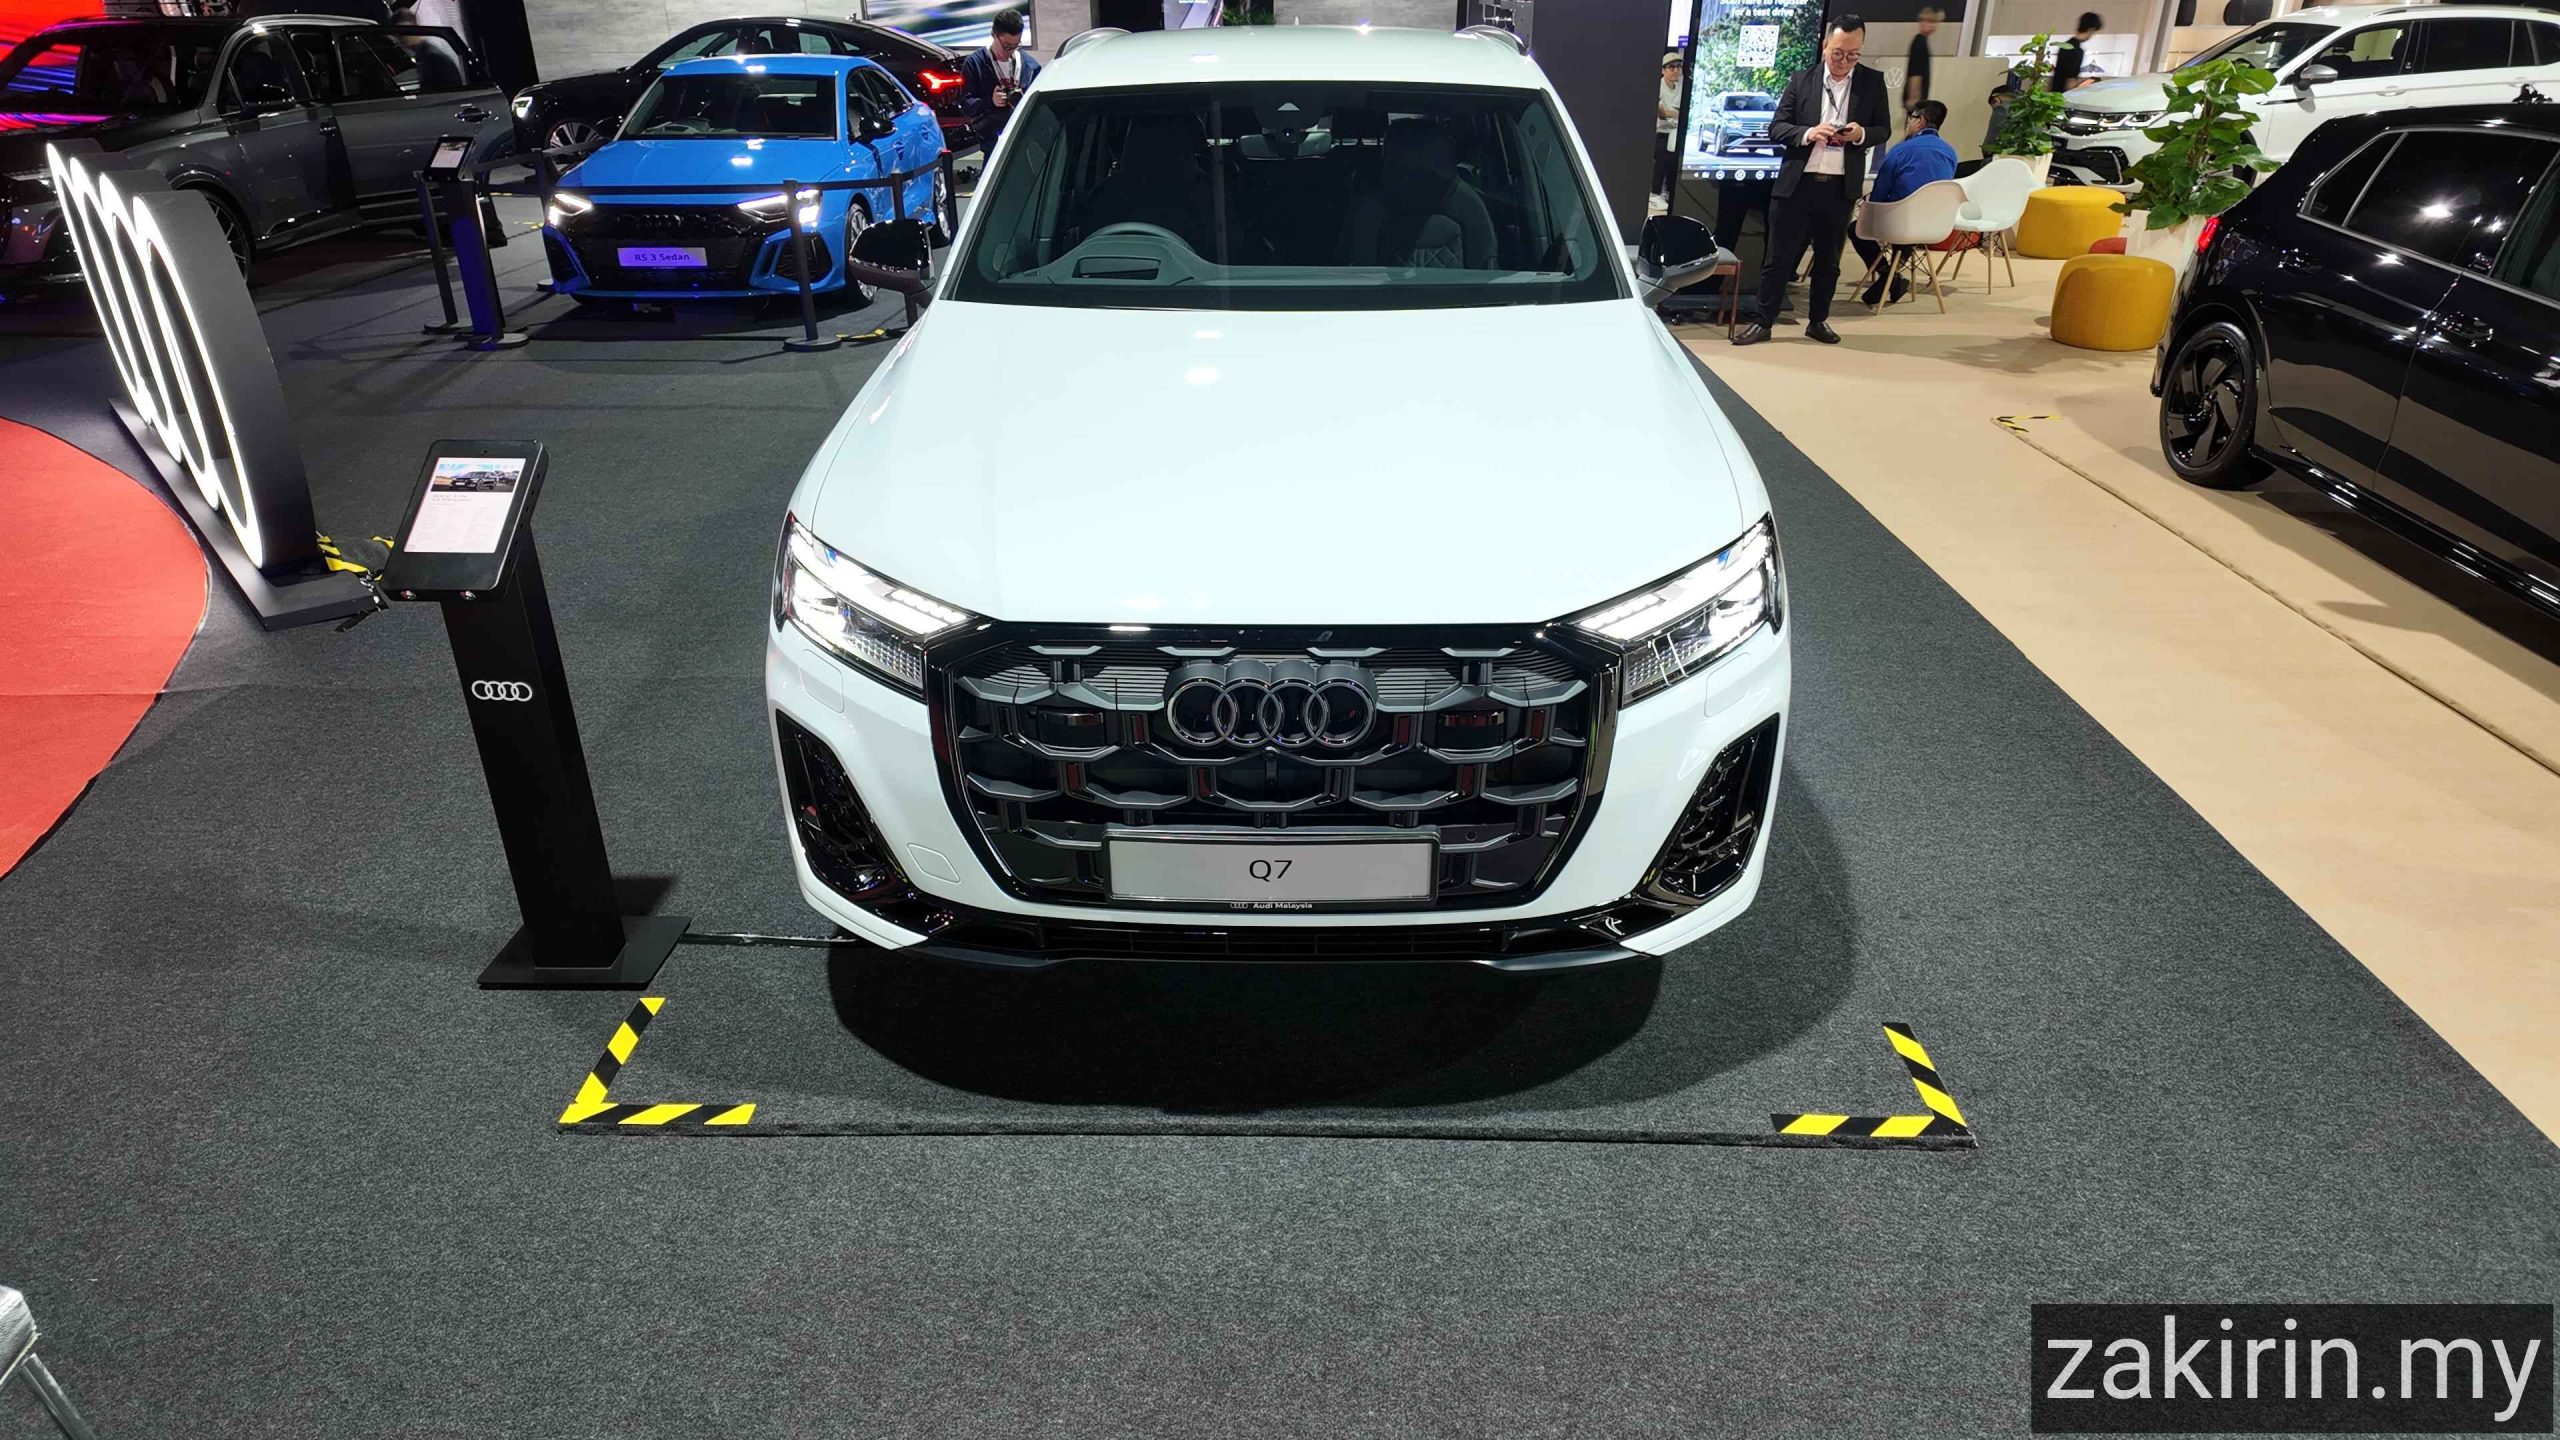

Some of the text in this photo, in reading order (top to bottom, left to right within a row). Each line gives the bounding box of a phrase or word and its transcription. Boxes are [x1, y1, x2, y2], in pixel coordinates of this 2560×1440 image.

[1753, 8, 1770, 16] test
[1772, 8, 1795, 16] drive
[634, 253, 690, 261] RS 3 Sedan
[1249, 859, 1293, 882] Q7
[1275, 902, 1313, 910] Malaysia
